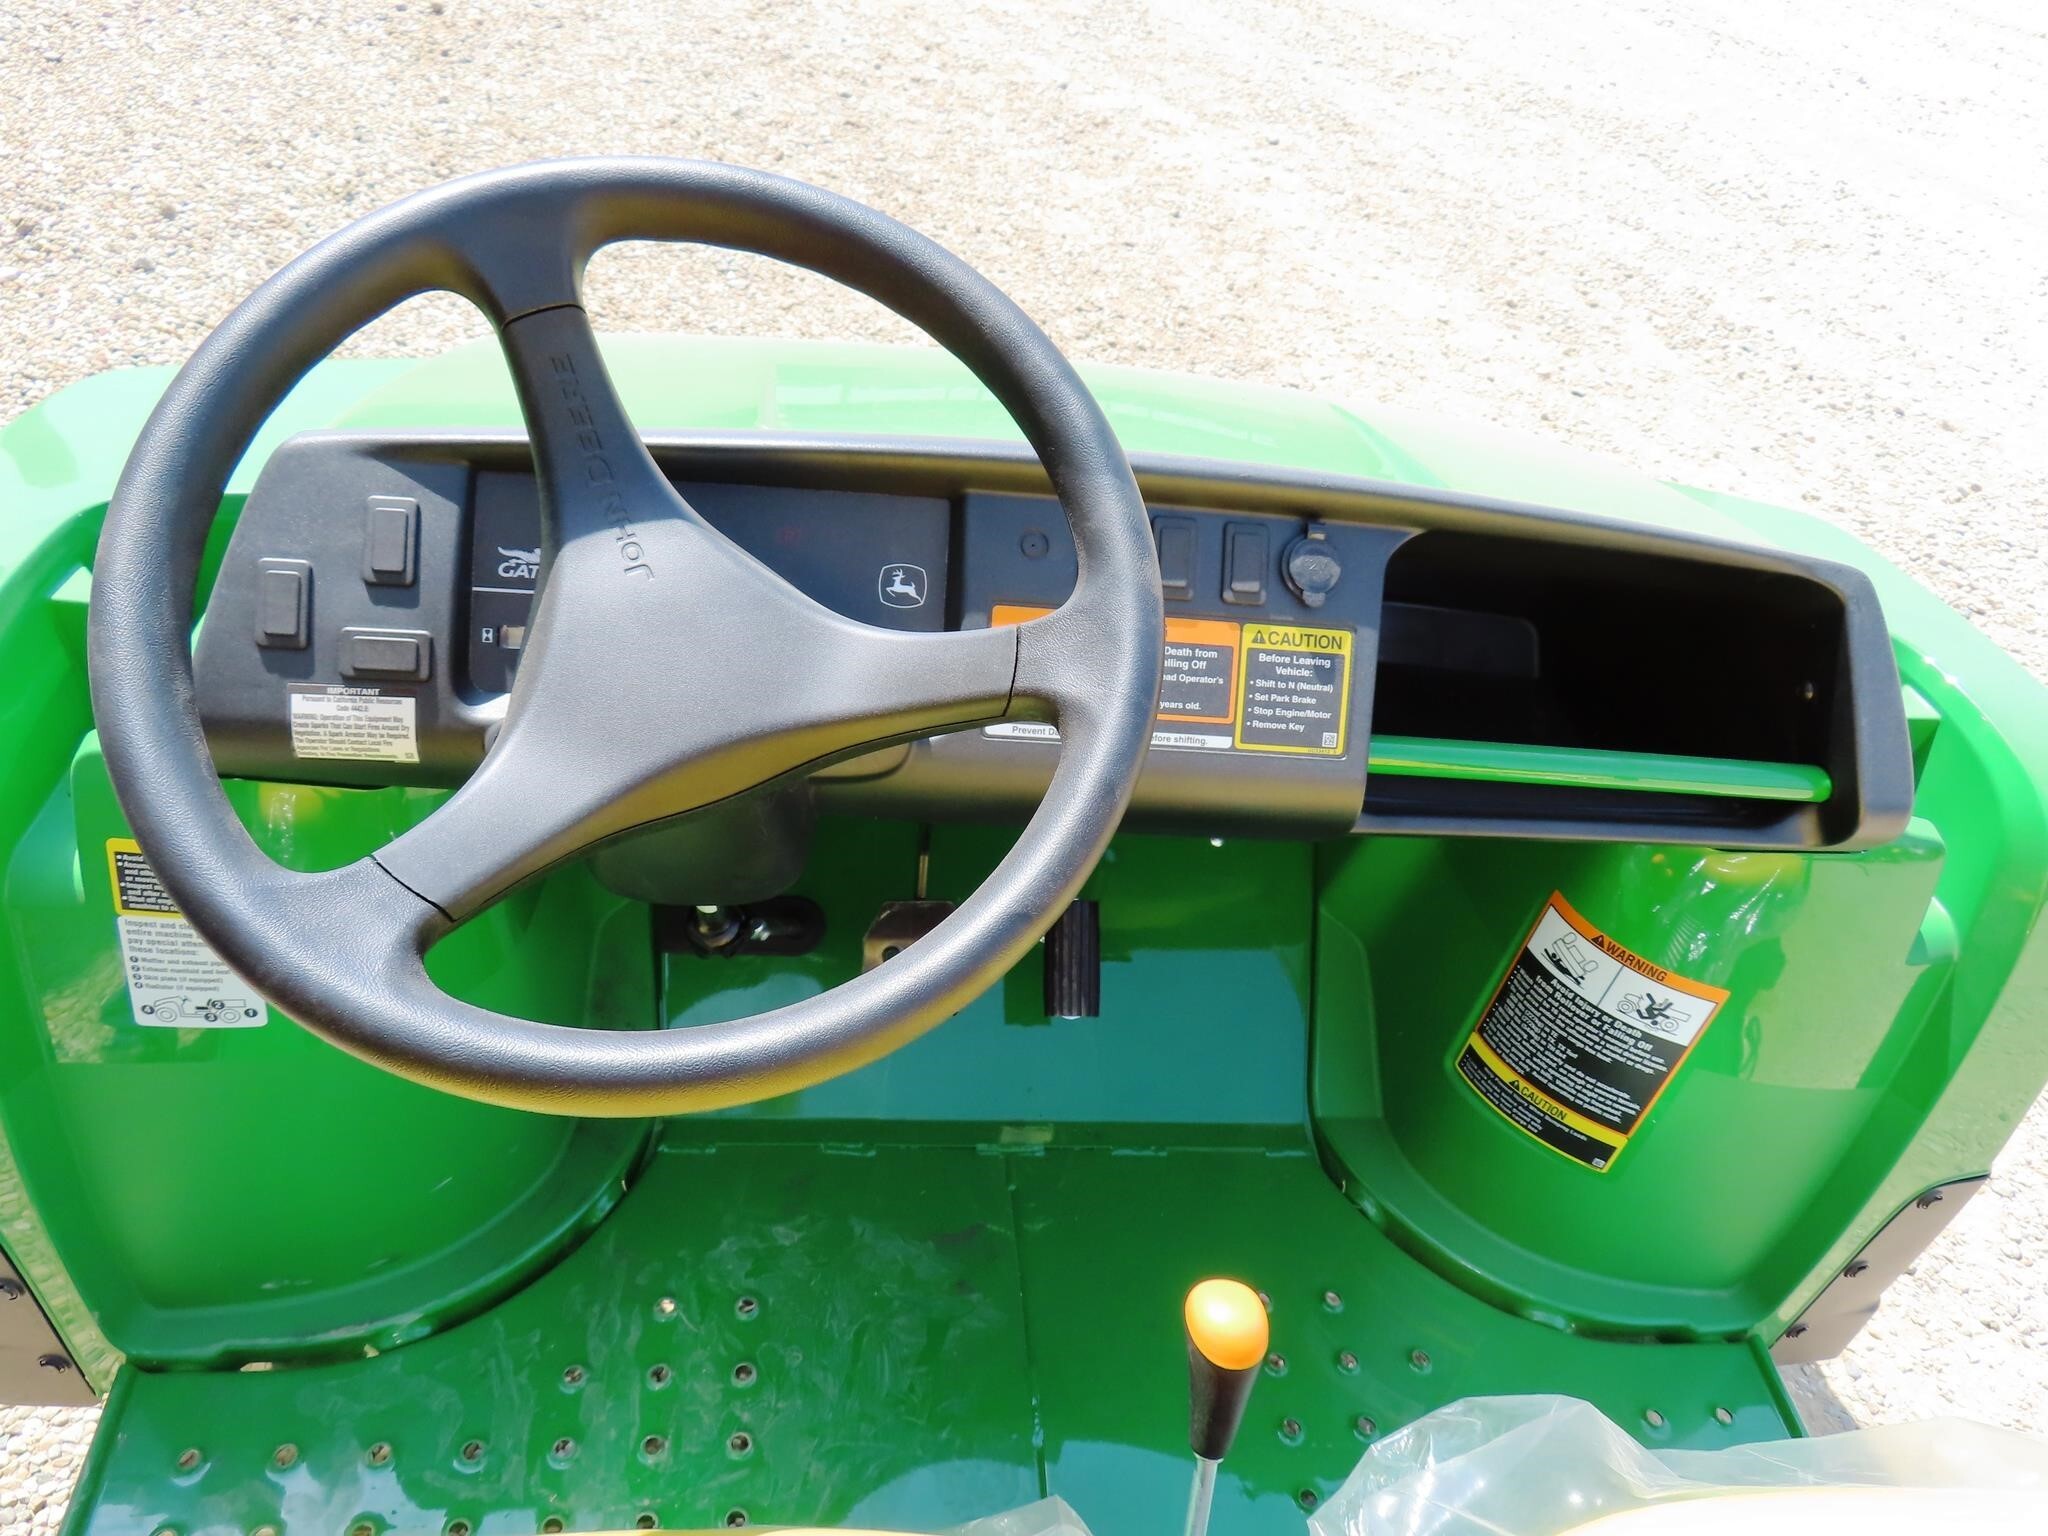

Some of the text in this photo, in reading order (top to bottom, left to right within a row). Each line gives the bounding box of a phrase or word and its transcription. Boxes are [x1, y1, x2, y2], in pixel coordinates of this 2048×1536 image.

[551, 352, 655, 582] JOHN DEERE
[498, 562, 540, 579] GAT
[1268, 631, 1342, 650] CAUTION
[1164, 646, 1218, 658] Death from
[1164, 659, 1207, 670] lling Off
[1259, 653, 1331, 668] Before Leaving
[1276, 666, 1313, 677] Vehicle:
[1163, 673, 1224, 684] ad Operator's
[327, 687, 380, 696] IMPORTANT
[1256, 679, 1276, 688] Shift
[1297, 682, 1334, 693] (Neutral)
[1254, 693, 1317, 704] Set Park Brake
[1160, 701, 1201, 710] years old.
[1254, 706, 1332, 718] Stop Engine/Motor
[1012, 726, 1046, 736] Prevent
[1252, 720, 1304, 732] Remove Key
[1152, 734, 1208, 746] fore shifting.
[1605, 941, 1667, 982] WARNING
[1535, 975, 1553, 993] from
[1554, 991, 1590, 1020] Rollover
[1590, 1017, 1602, 1027] or
[1602, 1023, 1635, 1046] Falling
[1637, 1040, 1652, 1051] Off
[1551, 978, 1642, 1038] Avoid Injury or Death
[1520, 1086, 1567, 1120] CAUTION
